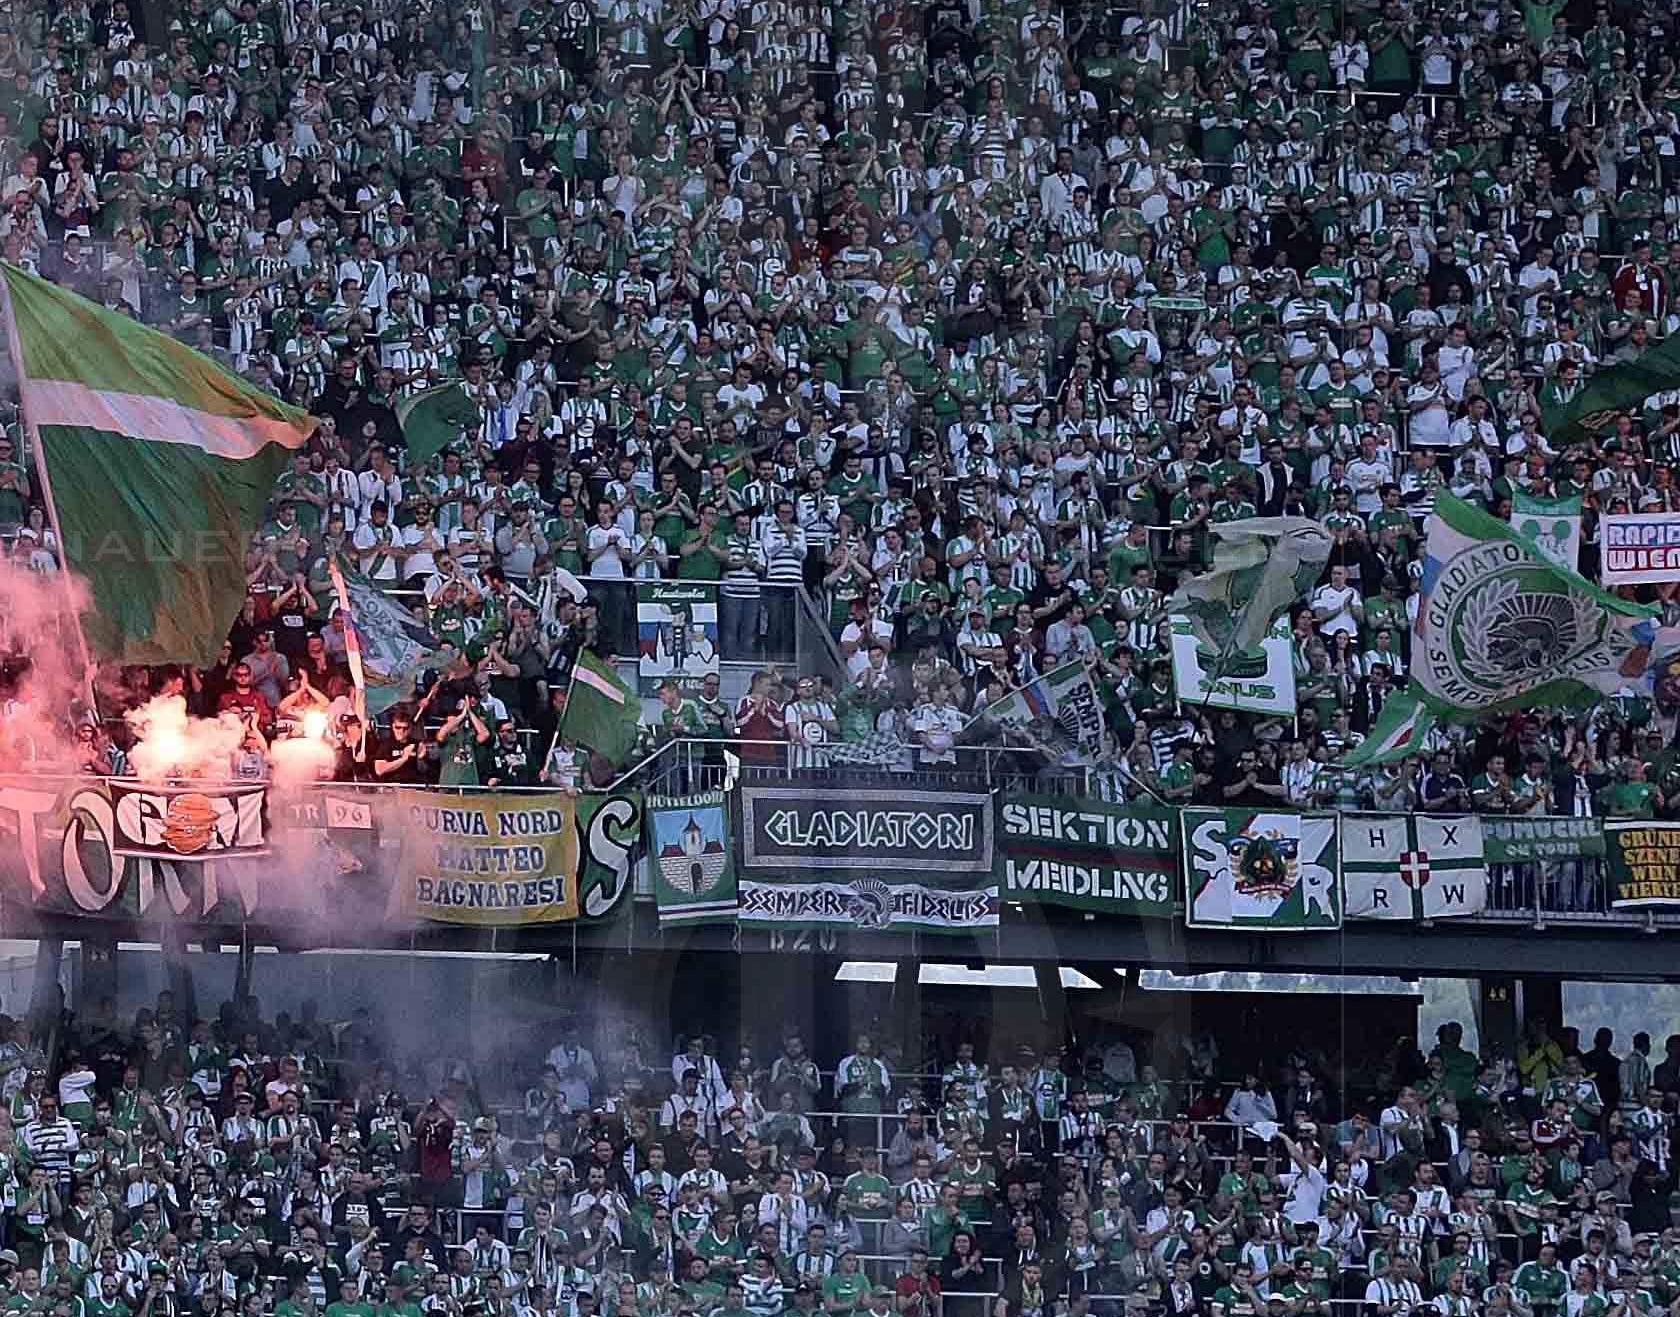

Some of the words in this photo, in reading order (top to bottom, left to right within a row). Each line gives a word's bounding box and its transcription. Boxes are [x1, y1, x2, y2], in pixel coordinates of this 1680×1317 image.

[409, 809, 488, 836] CURVA
[498, 808, 562, 835] NORD
[765, 808, 974, 850] GLADIATORI
[1002, 803, 1169, 849] SEKTION
[438, 846, 545, 874] MATTEO
[417, 878, 567, 908] BAGNARESI
[1006, 859, 1169, 904] MEIDLING
[743, 888, 845, 917] SEMPER
